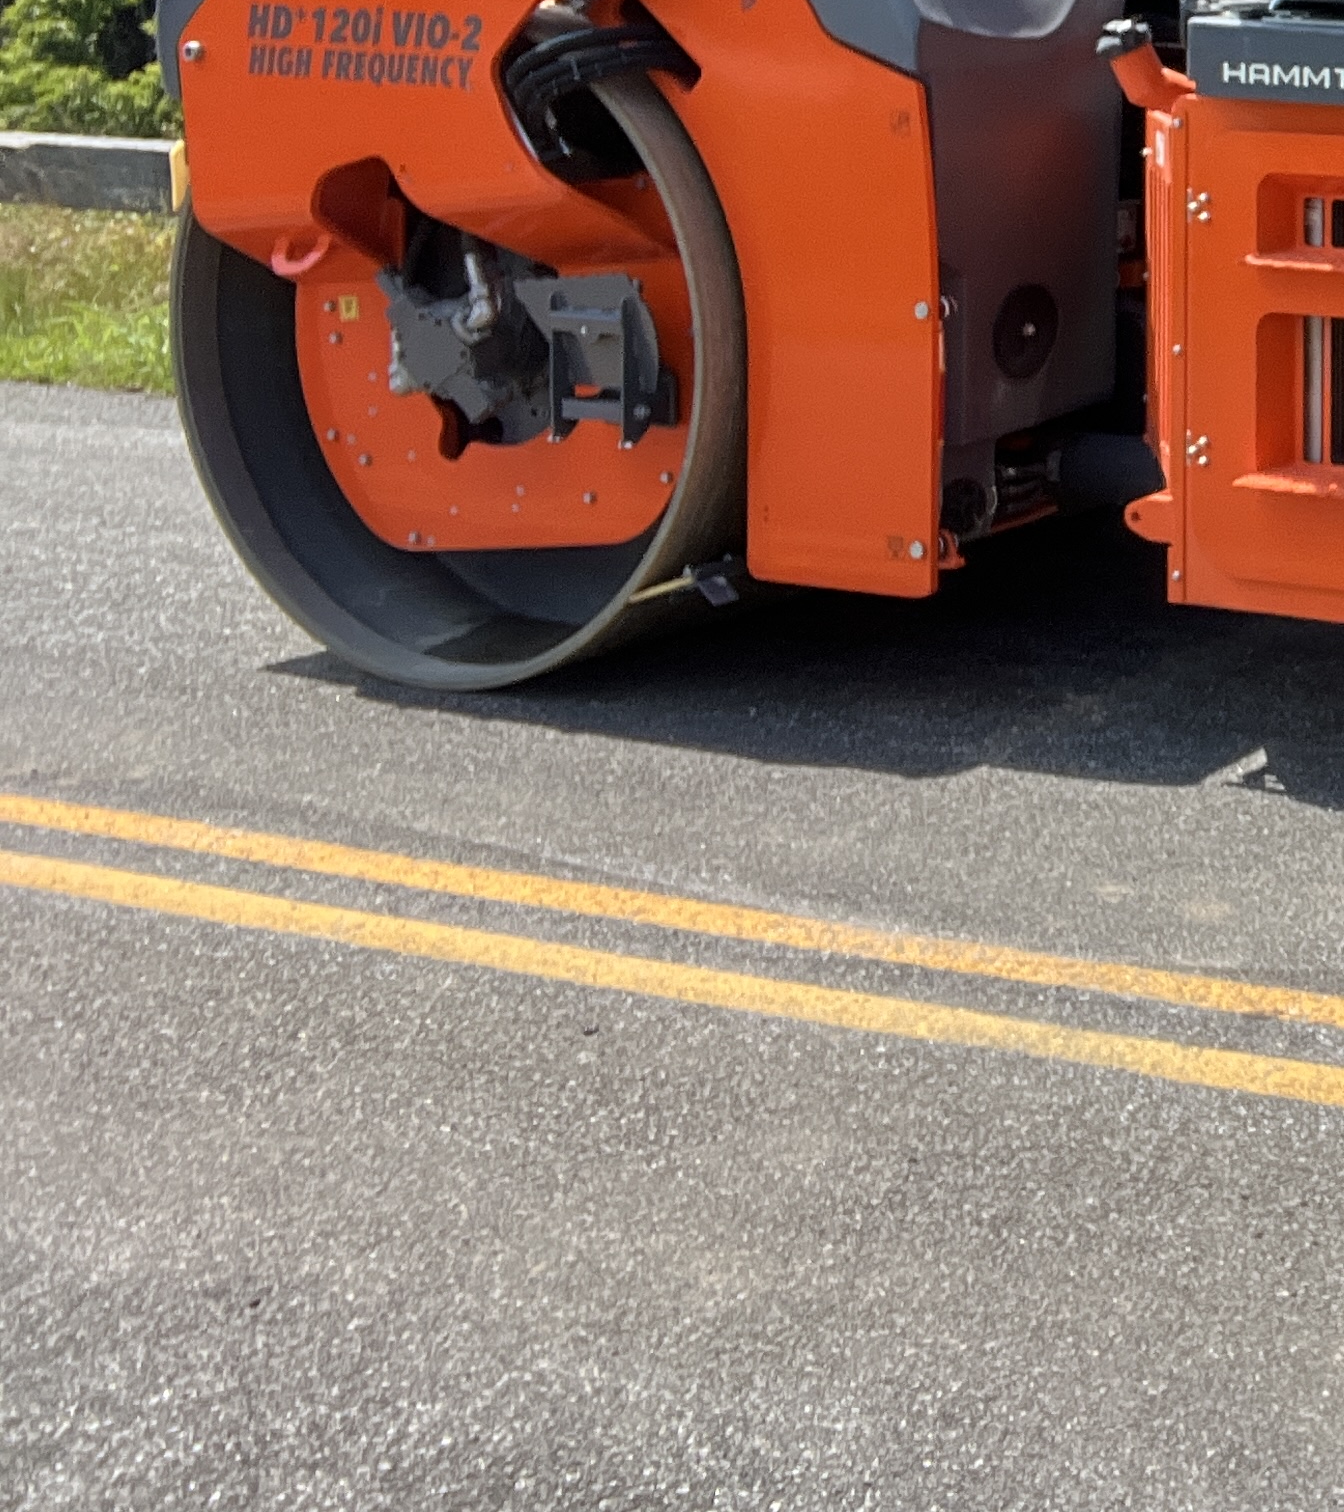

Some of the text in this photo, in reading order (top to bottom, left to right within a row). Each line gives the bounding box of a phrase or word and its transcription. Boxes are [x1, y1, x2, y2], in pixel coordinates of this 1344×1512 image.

[392, 11, 484, 52] VIO-2
[249, 45, 475, 88] HIGH FREQUENCY
